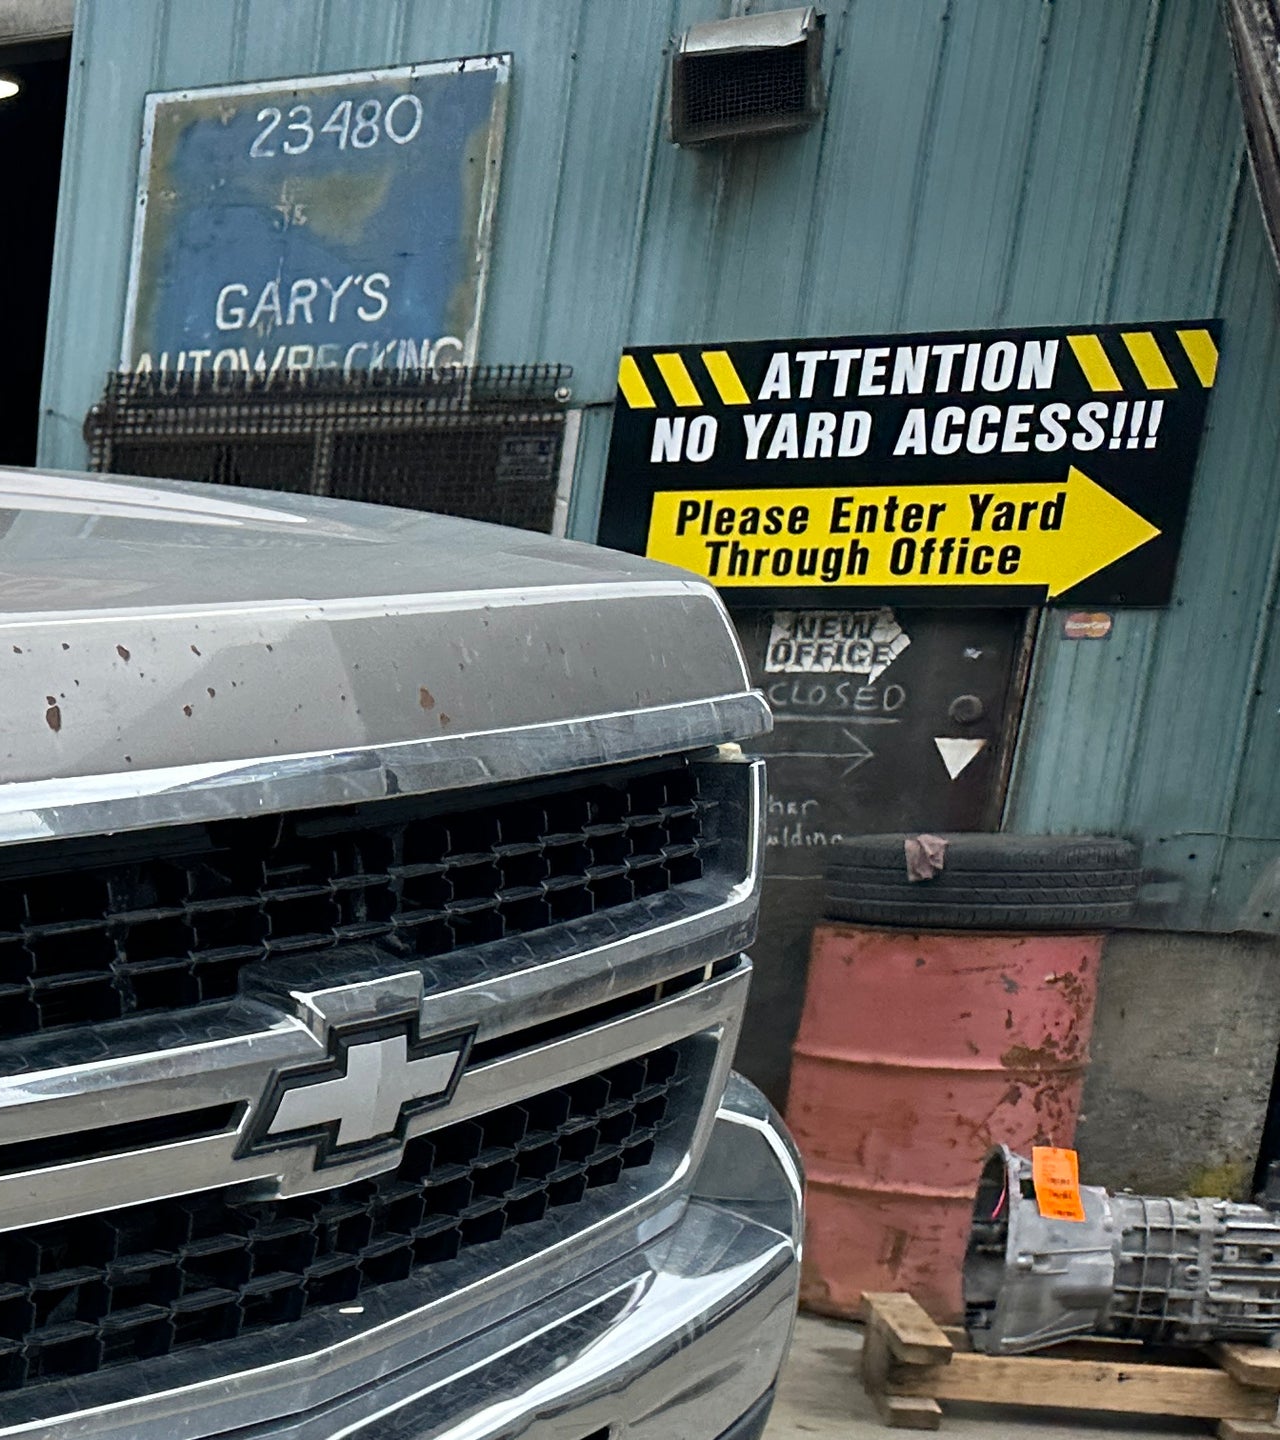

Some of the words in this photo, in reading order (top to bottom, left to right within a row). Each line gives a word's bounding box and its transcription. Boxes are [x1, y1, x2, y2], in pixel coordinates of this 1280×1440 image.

[249, 94, 422, 158] 23480
[216, 272, 390, 330] GARY'S
[758, 340, 1060, 400] ATTENTION
[650, 415, 718, 463] NO
[743, 411, 872, 460] YARD
[892, 400, 1164, 456] ACCESS!!!
[675, 499, 810, 536] Please
[829, 495, 947, 534] Enter
[969, 492, 1067, 532] Yard
[705, 539, 870, 583] Through
[889, 537, 1021, 576] Office
[794, 612, 876, 640] NEW
[770, 641, 892, 667] OFFICE
[769, 681, 907, 712] CLOSED
[768, 794, 819, 815] her
